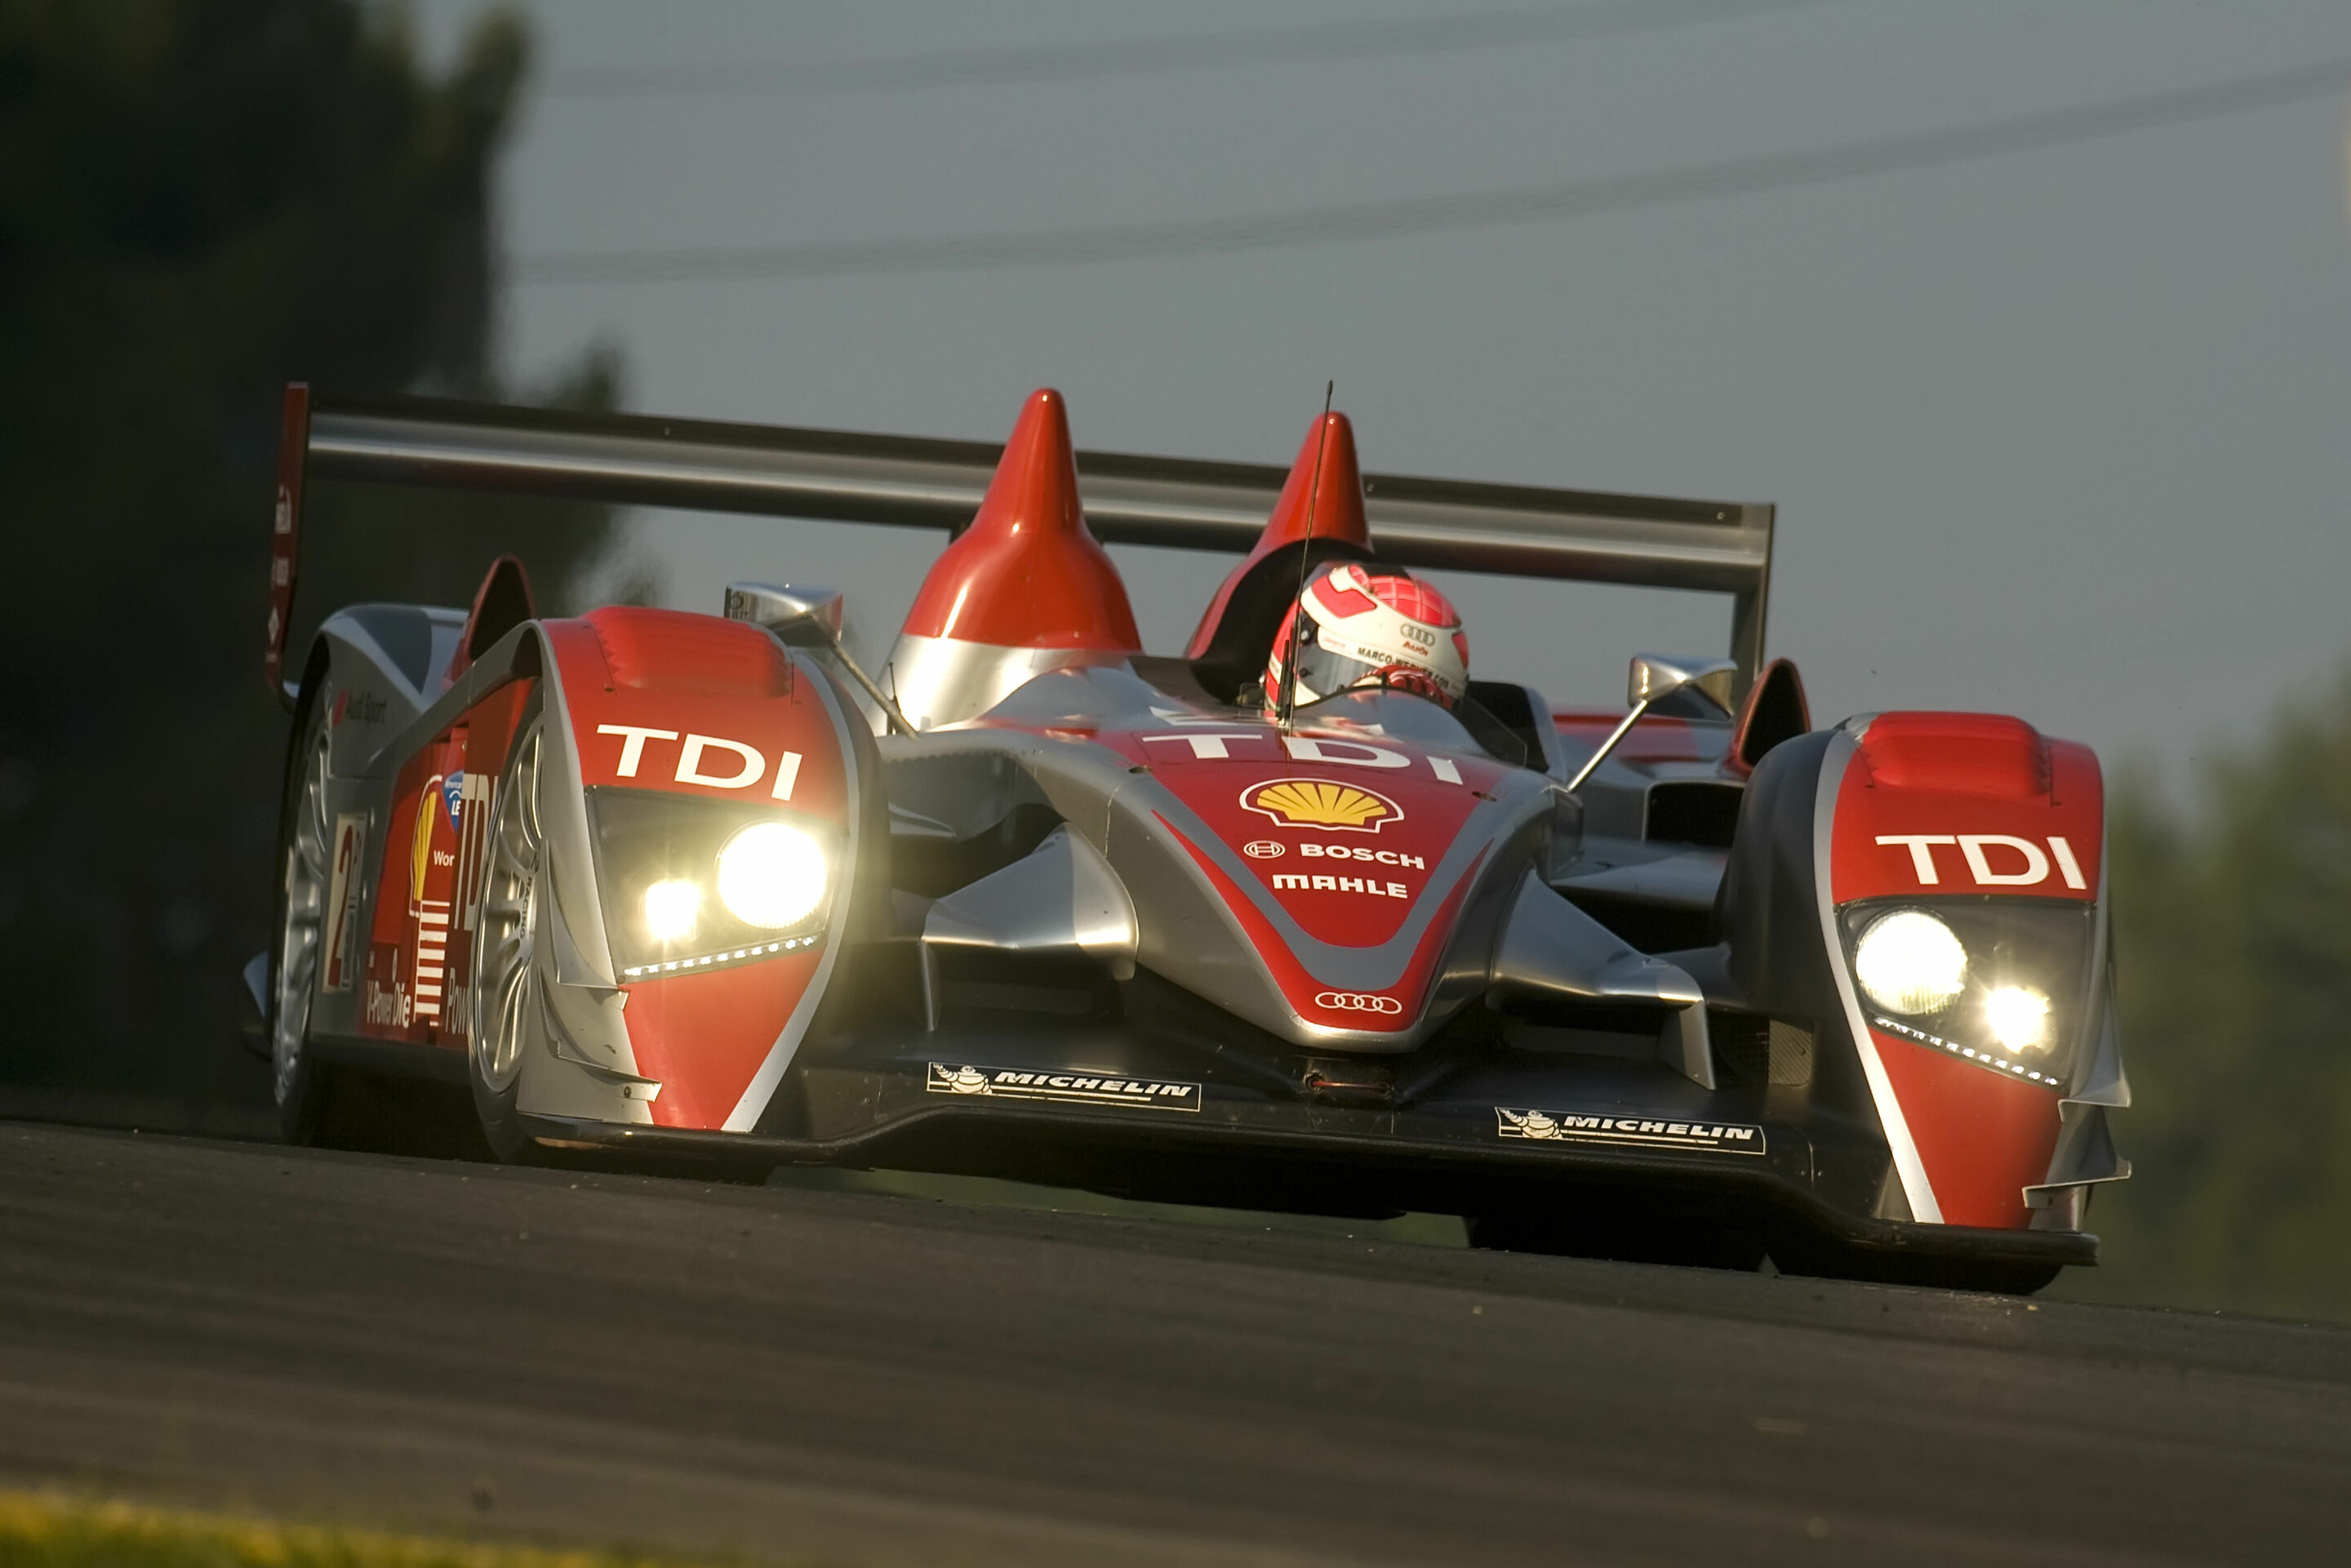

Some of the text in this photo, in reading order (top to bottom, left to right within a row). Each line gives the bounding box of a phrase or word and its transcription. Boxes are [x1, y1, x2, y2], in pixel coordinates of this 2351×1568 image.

[1402, 641, 1429, 657] Audi
[597, 724, 803, 802] TDI
[1142, 735, 1464, 785] TDI
[433, 850, 455, 867] Wor
[1300, 843, 1425, 870] BOSCH
[1874, 834, 2087, 890] TDI
[1273, 874, 1408, 899] MAHLE
[328, 824, 353, 988] 2
[993, 1072, 1192, 1097] MICHELIN
[1563, 1116, 1753, 1140] MICHELIN
